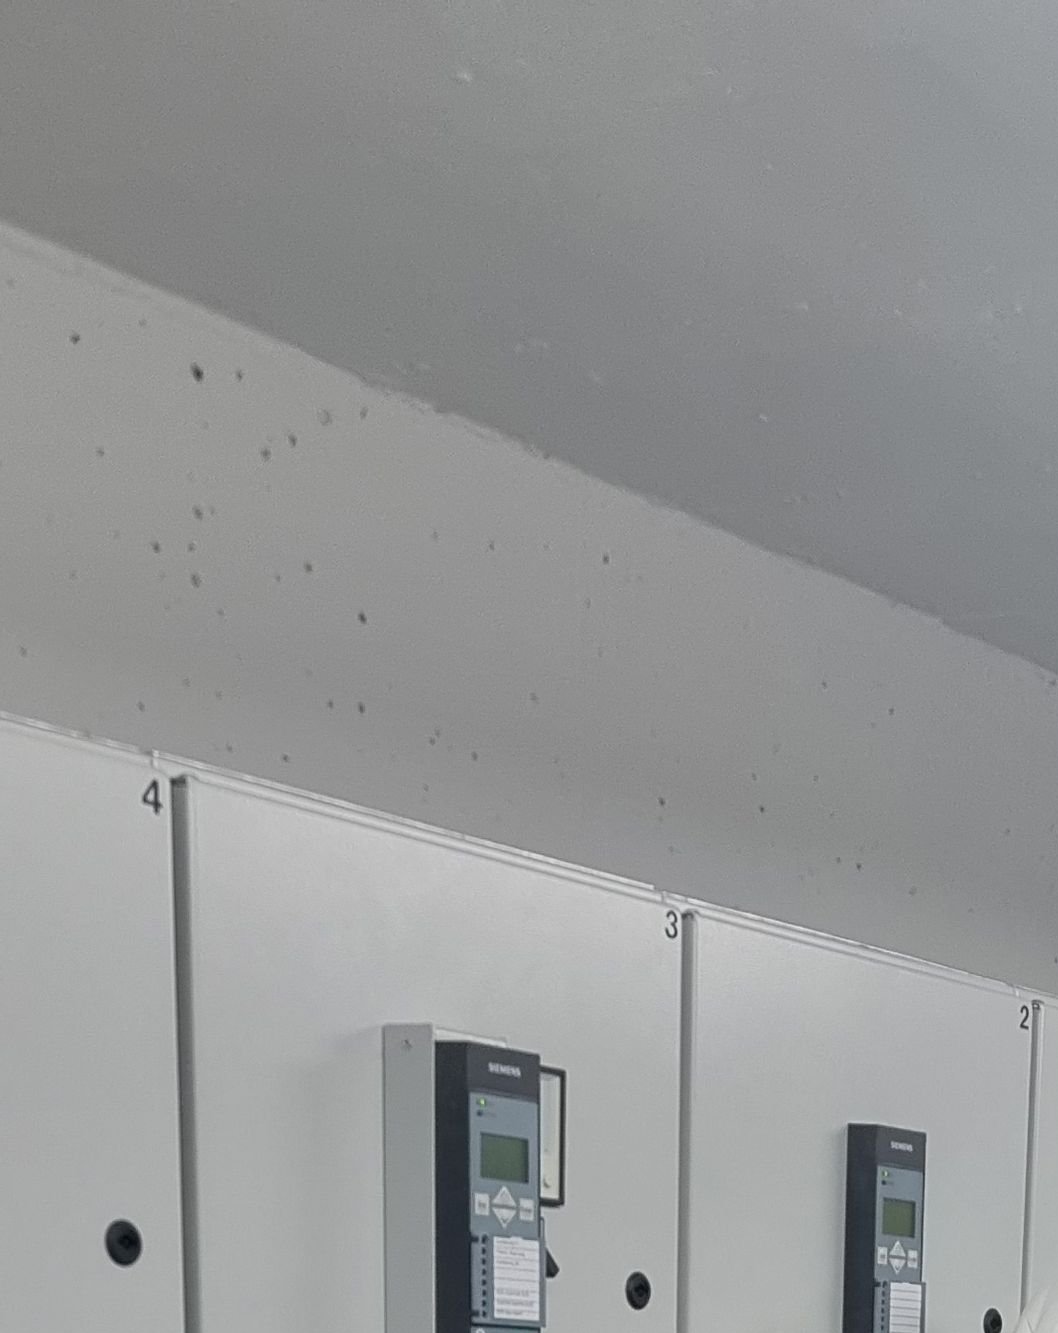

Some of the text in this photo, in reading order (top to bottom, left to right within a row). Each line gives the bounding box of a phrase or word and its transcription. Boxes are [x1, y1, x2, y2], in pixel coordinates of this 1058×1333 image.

[142, 779, 163, 816] 4
[665, 910, 678, 939] 3
[1020, 1005, 1029, 1030] 2
[488, 1062, 521, 1077] SIEMENS
[890, 1140, 913, 1152] SIEMENS
